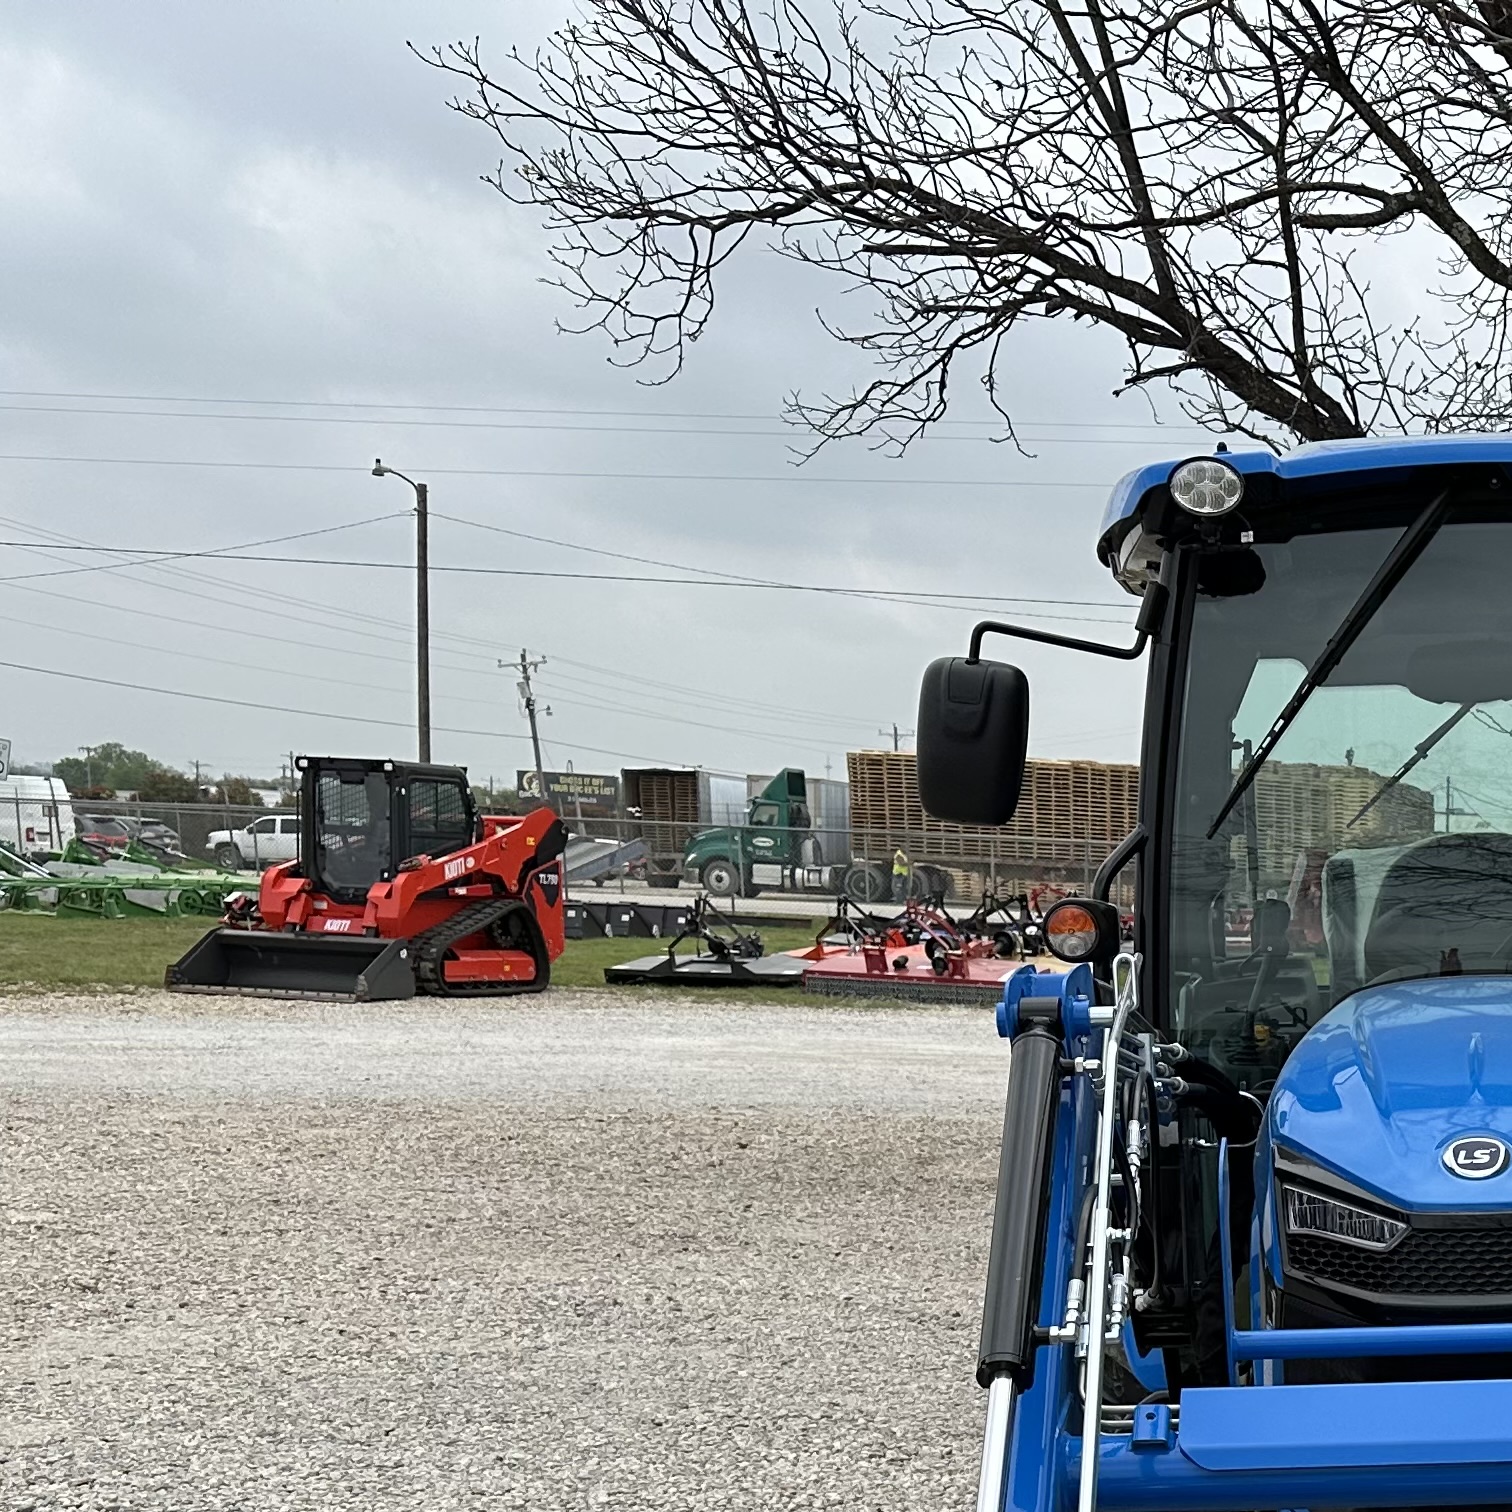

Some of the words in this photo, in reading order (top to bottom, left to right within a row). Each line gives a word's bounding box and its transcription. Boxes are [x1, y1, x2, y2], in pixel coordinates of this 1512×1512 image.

[444, 857, 466, 881] KIOTI
[323, 918, 352, 931] KIOTI
[1457, 1148, 1497, 1164] LS
